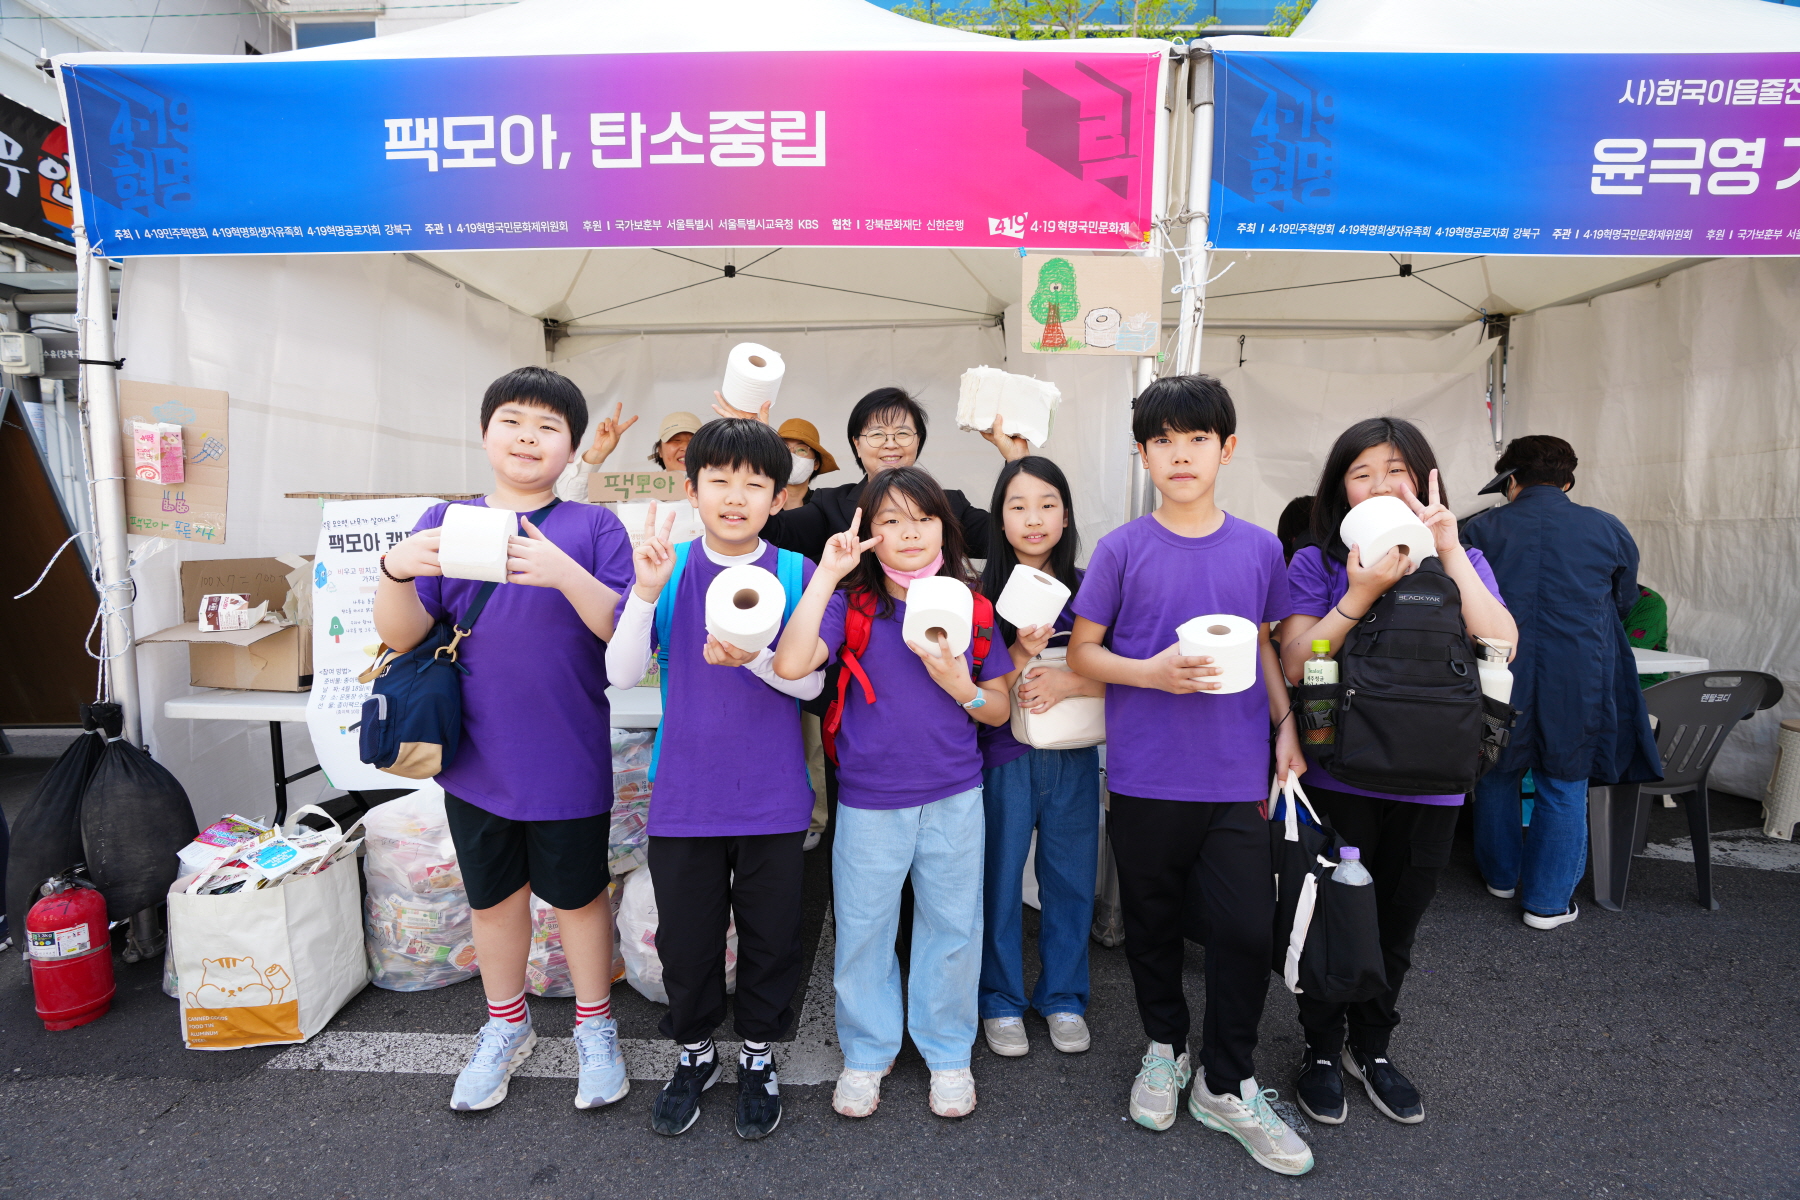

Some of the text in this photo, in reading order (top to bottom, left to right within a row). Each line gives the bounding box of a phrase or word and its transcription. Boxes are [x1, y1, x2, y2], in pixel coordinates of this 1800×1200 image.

[384, 110, 826, 172] 팩모아, 탄소중립
[1590, 137, 1767, 196] 윤극영
[114, 228, 134, 241] 주최
[144, 227, 208, 240] 4·19민주혁명회
[212, 226, 304, 239] 4·19혁명희생자유족회
[307, 225, 381, 237] 4·19혁명공로자회
[384, 224, 413, 236] 강북구
[424, 223, 444, 235] 주관
[456, 221, 569, 235] 4·19혁명국민문화제위원회
[582, 220, 602, 232] 후원
[614, 219, 663, 232] 국가보훈부
[666, 218, 714, 231] 서울특별시
[718, 218, 794, 231] 서울특별시교육청
[798, 219, 819, 230] KBS
[831, 218, 852, 231] 협찬
[864, 218, 922, 231] 강북문화재단
[926, 218, 965, 232] 신한은행
[1236, 223, 1256, 235] 주최
[1269, 223, 1335, 236] 4·19민주혁명회
[1338, 224, 1431, 238] 4·19혁명희생자유족회
[1434, 226, 1509, 239] 4·19혁명공로자회
[1512, 227, 1541, 240] 강북구
[1551, 228, 1572, 240] 주관
[1582, 228, 1693, 241] 4·19혁명국민문화제위원회
[1705, 229, 1725, 241] 후원
[1736, 229, 1783, 241] 국가보훈부
[604, 473, 676, 500] 팩모아
[129, 516, 170, 531] 팩모아
[174, 520, 192, 539] 푸른
[328, 531, 413, 554] 팩모아 캠
[1700, 693, 1731, 703] 렌탈코디
